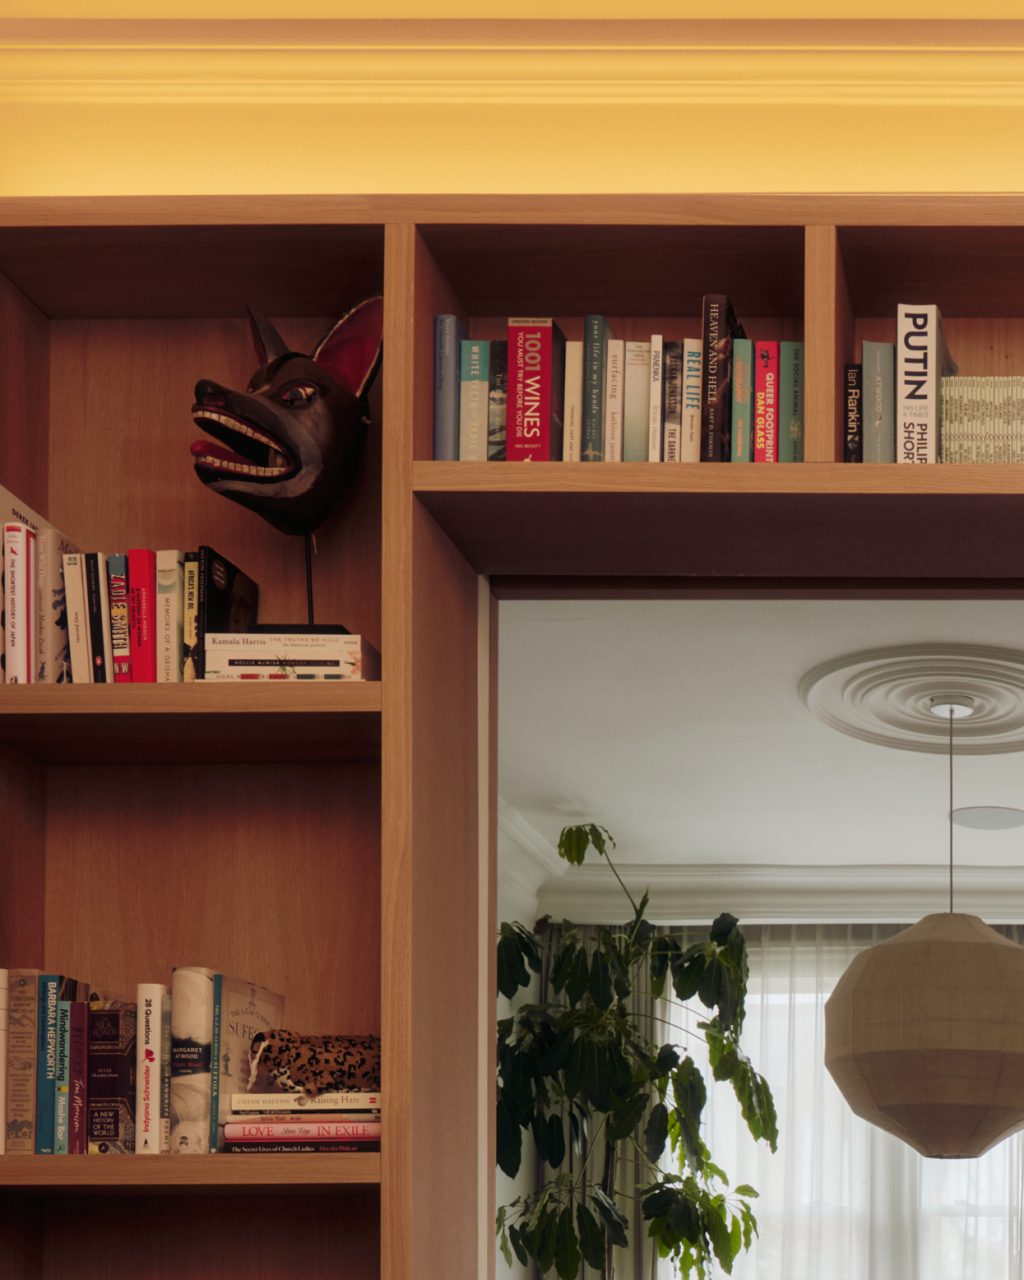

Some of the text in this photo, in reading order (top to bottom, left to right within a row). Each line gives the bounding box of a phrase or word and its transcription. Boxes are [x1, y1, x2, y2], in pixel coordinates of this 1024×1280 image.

[471, 345, 480, 376] WHITE
[525, 332, 541, 372] 1001
[652, 350, 660, 382] PANENKA
[708, 304, 718, 405] HEAVEN AND HELL
[904, 312, 928, 400] PUTIN
[609, 354, 618, 400] surfacing
[686, 352, 701, 410] REAL LIFE
[766, 372, 774, 404] QUEER
[523, 376, 541, 438] WINES
[756, 392, 764, 449] DAN GLASS
[848, 370, 860, 432] Ian Rankin
[668, 428, 676, 438] THE
[110, 575, 127, 609] ZADIE
[164, 634, 170, 644] OF
[212, 638, 266, 646] Kamala Harris
[46, 982, 56, 1079] BARBARA HEPWORTH
[144, 998, 152, 1045] 28 Questions
[57, 1008, 68, 1082] Mindwandering
[242, 1126, 274, 1136] LOVE
[318, 1126, 370, 1136] IN EXILE
